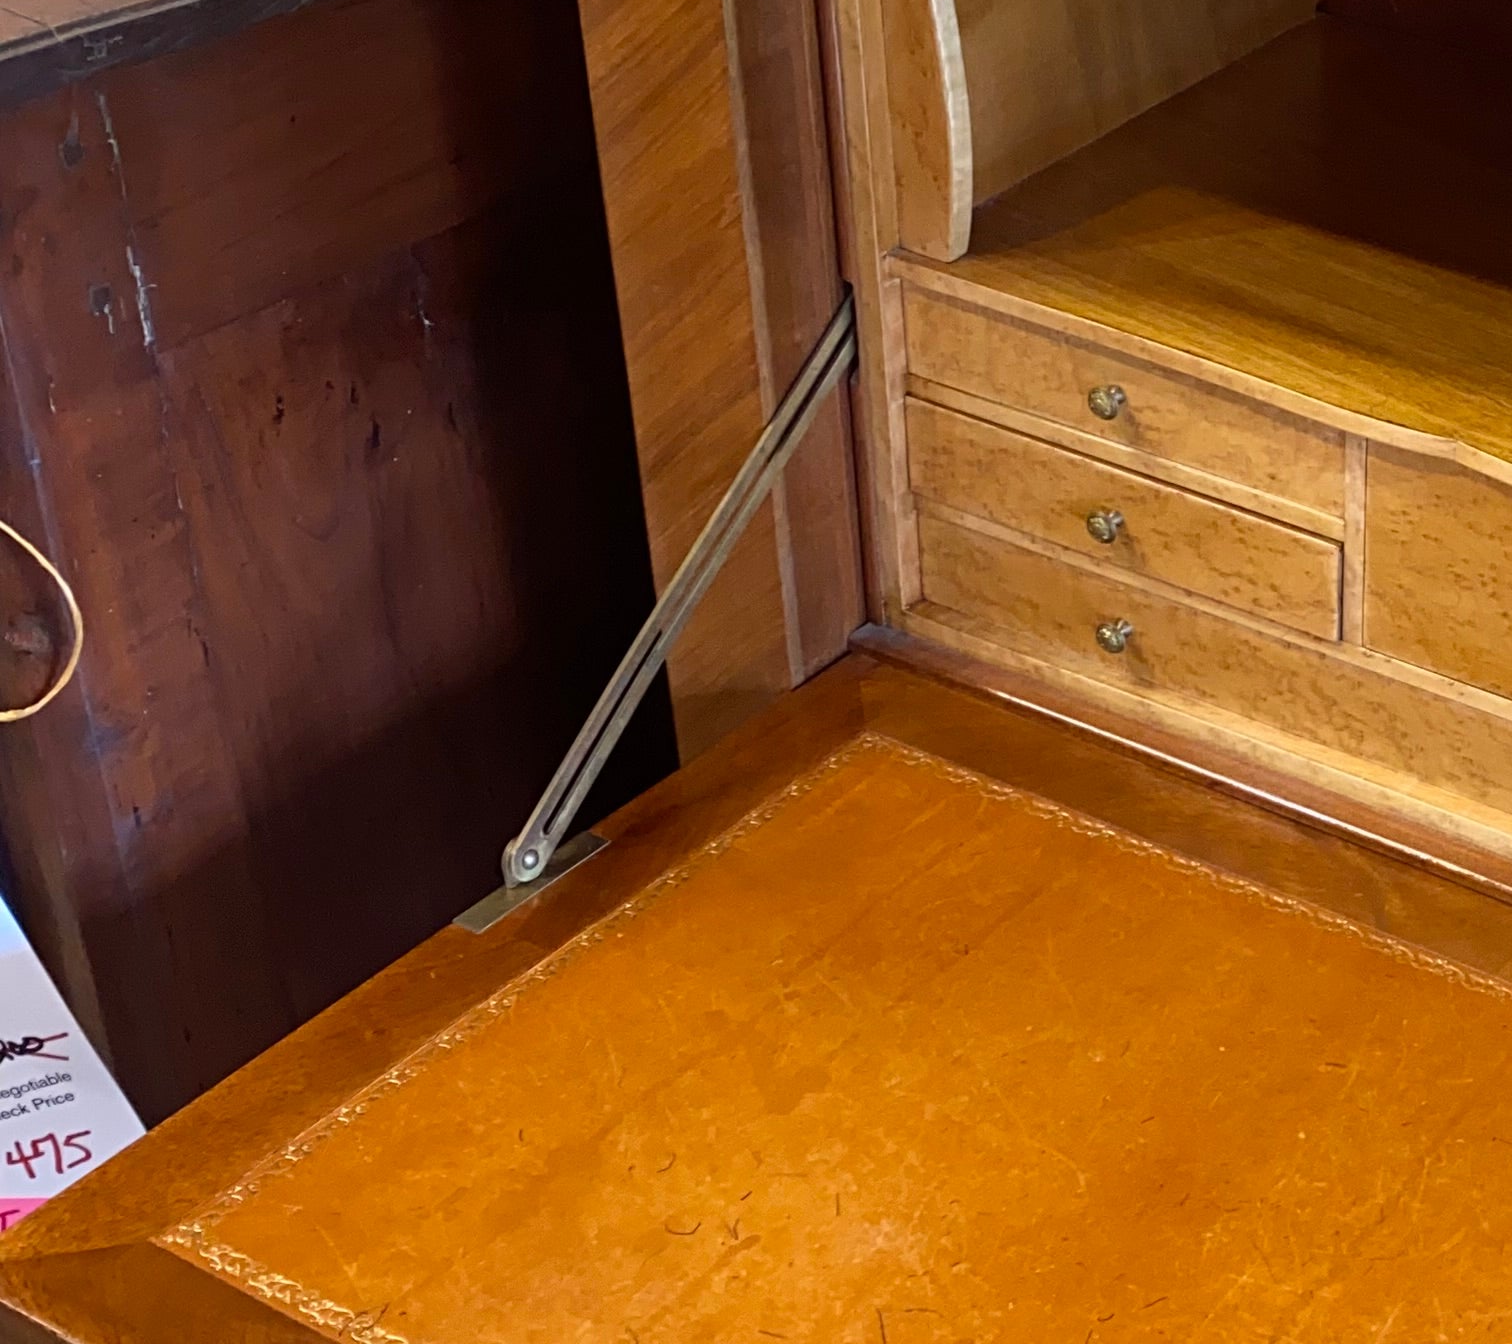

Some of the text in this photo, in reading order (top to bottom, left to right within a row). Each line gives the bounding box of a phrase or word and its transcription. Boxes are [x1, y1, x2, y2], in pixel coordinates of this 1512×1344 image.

[0, 1072, 72, 1099] egotiable
[0, 1093, 75, 1120] eck Price
[6, 1130, 92, 1179] 475
